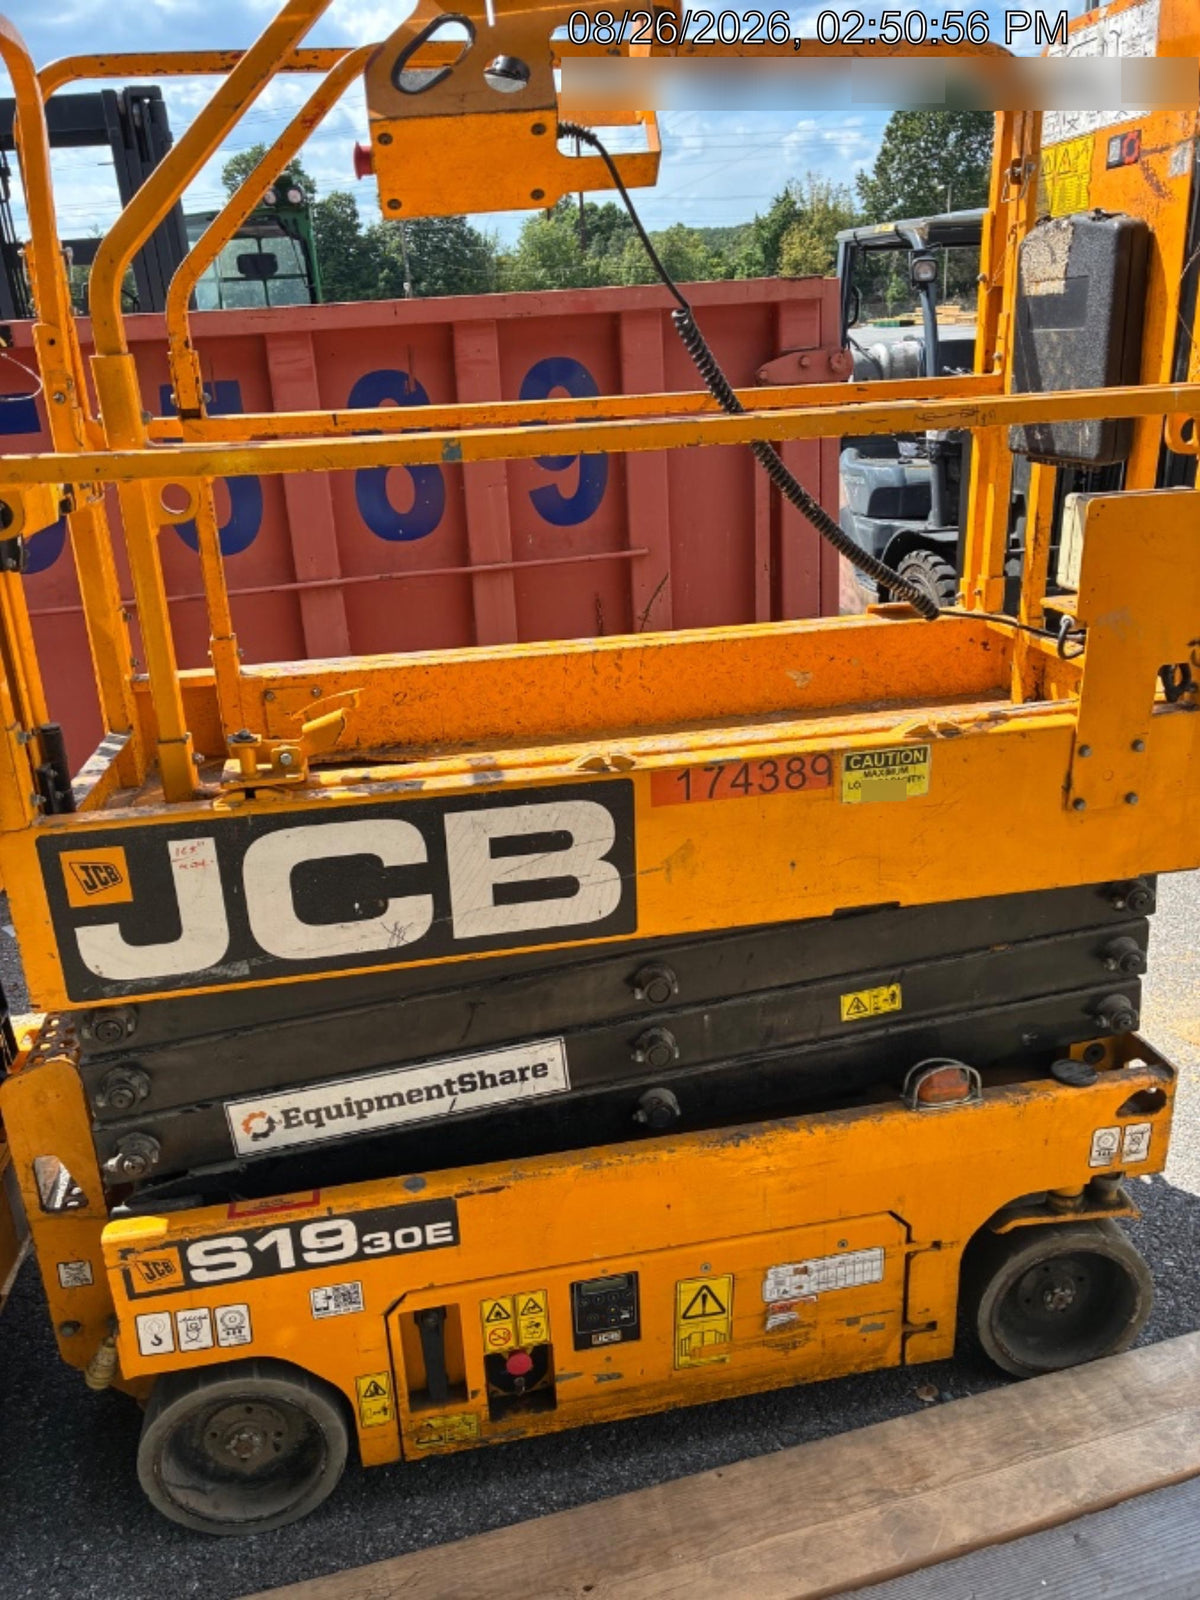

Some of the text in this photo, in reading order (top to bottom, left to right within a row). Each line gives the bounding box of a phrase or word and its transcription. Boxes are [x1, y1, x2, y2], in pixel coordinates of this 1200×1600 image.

[677, 753, 834, 800] 174389
[850, 750, 924, 769] CAUTION
[74, 800, 621, 979] JCB
[79, 865, 121, 891] JCB
[280, 1062, 549, 1129] EquipmentShare
[142, 1261, 174, 1281] JCB
